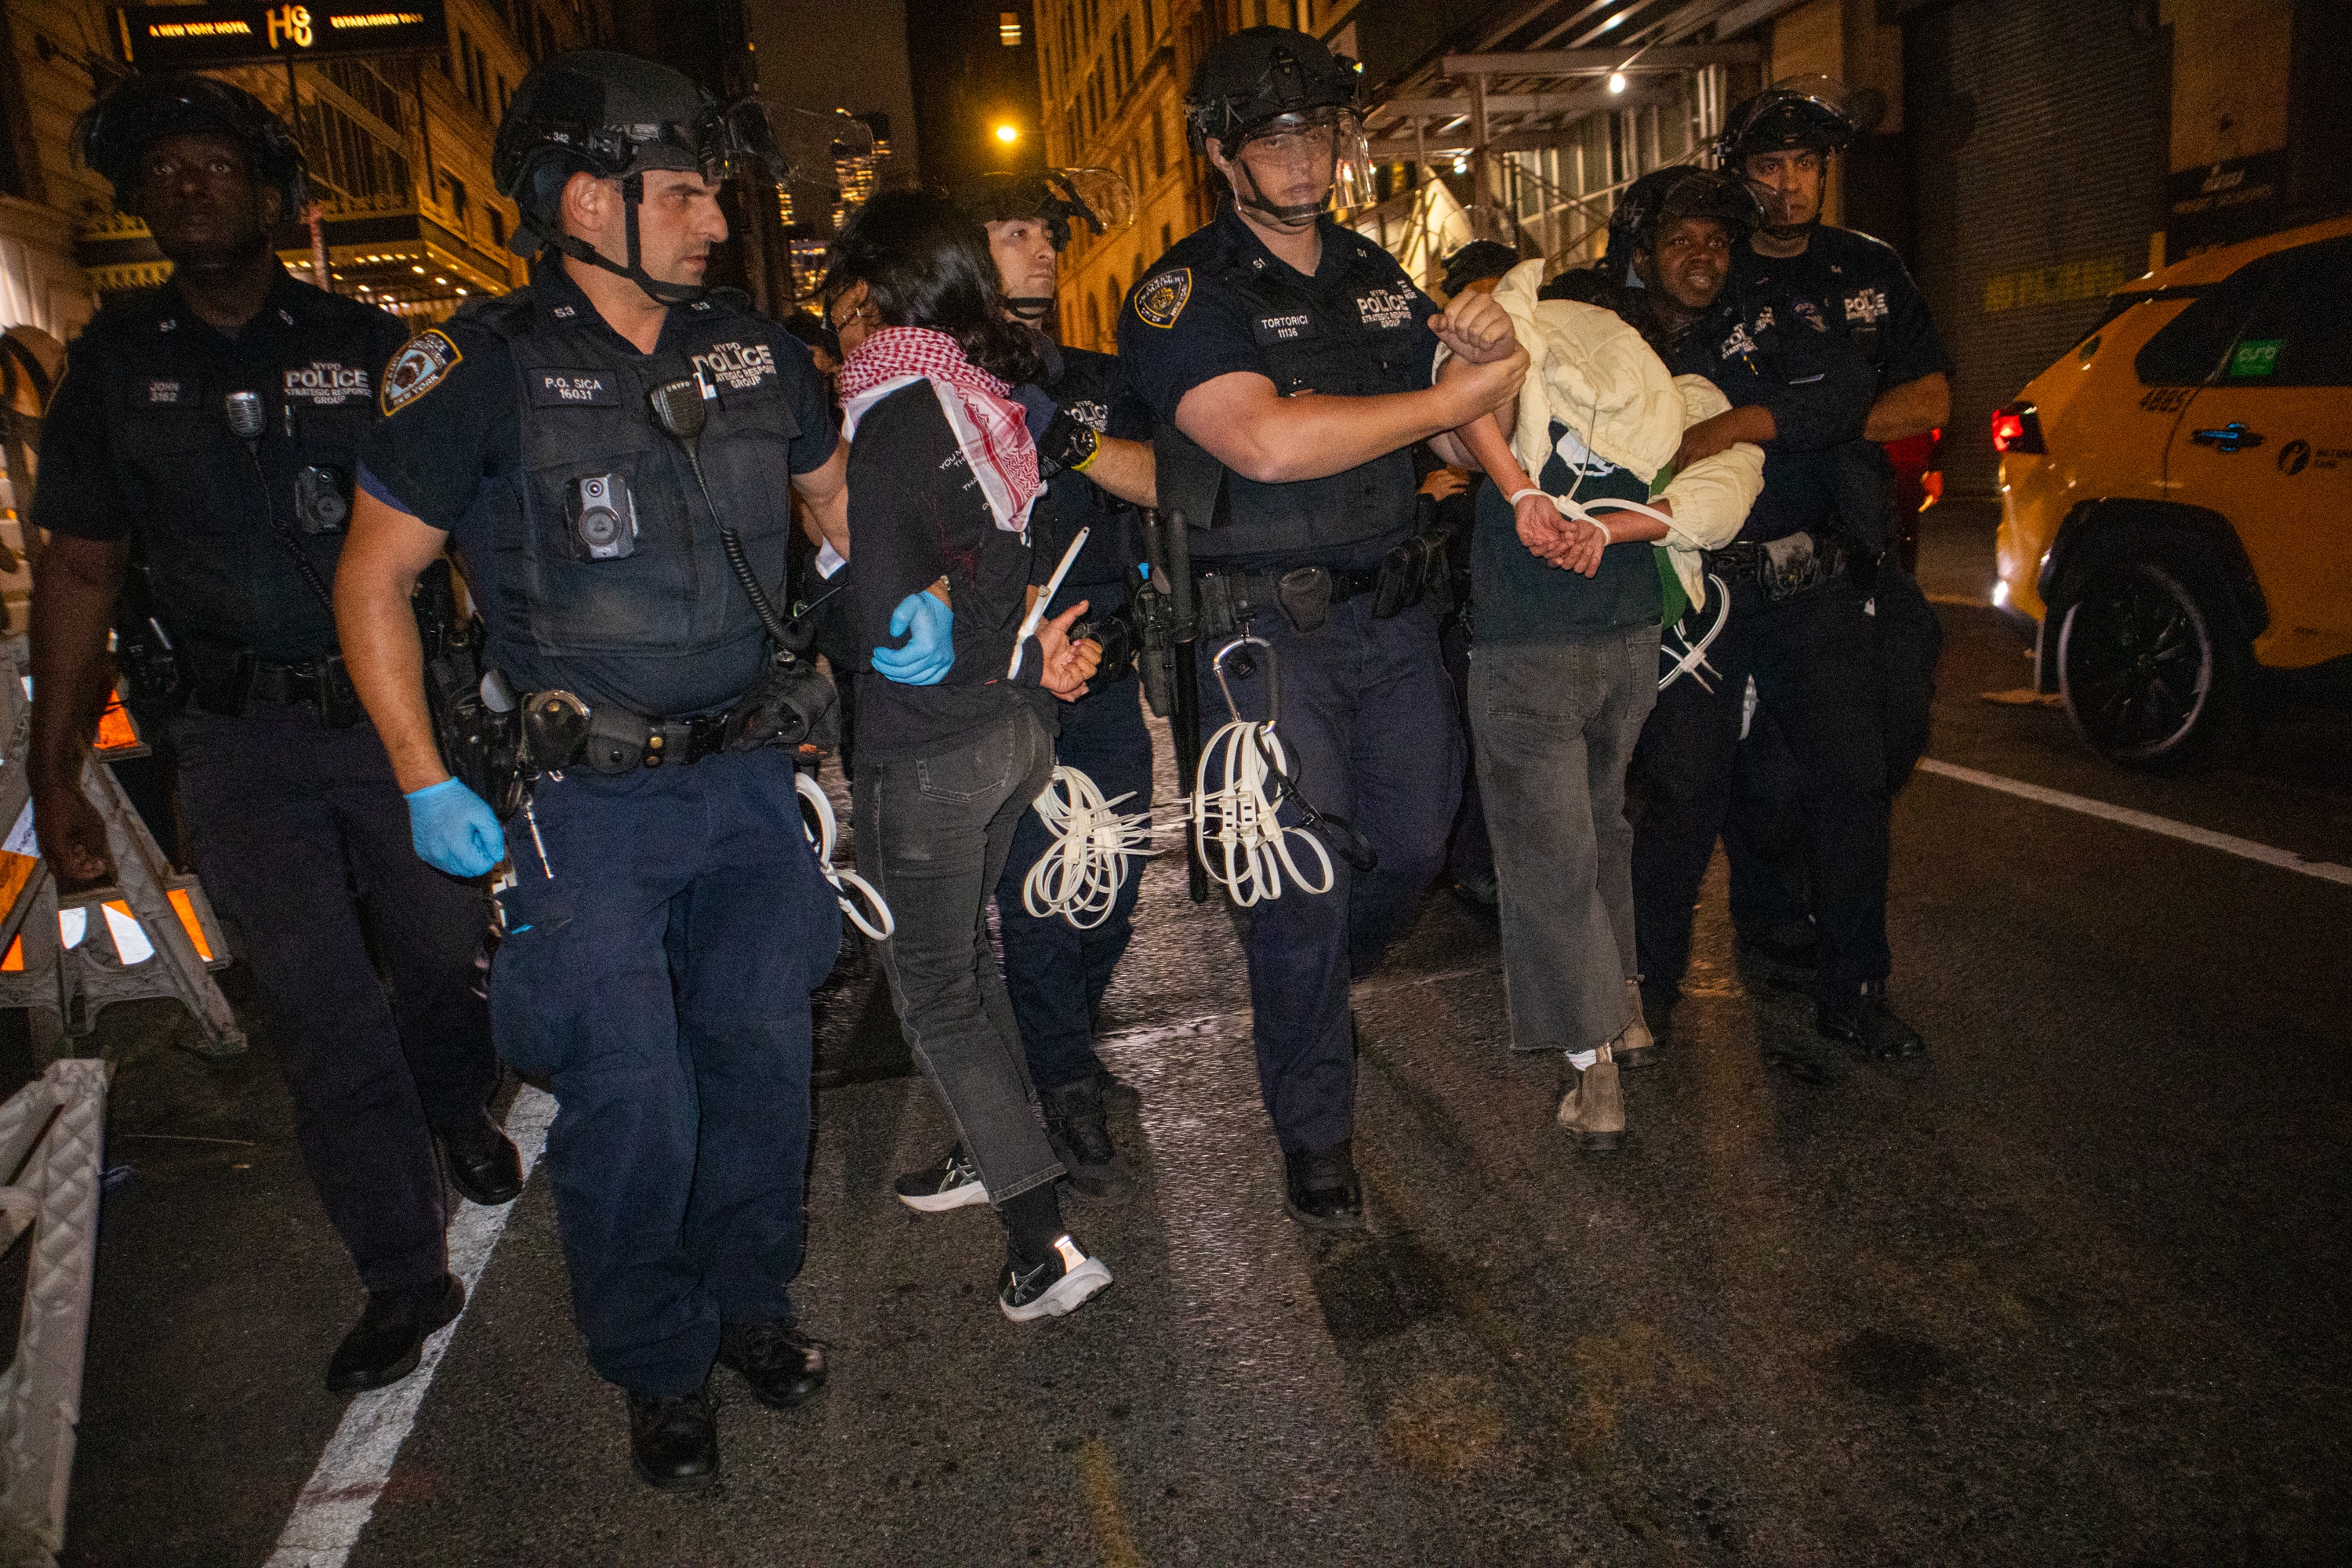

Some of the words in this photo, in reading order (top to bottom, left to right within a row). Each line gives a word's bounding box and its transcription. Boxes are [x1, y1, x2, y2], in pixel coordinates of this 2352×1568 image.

[330, 13, 399, 29] ESTABLISHED
[158, 24, 185, 37] NEW
[183, 21, 216, 36] YORK
[213, 20, 252, 34] HOTEL
[553, 132, 570, 144] 342
[1356, 294, 1410, 315] POLICE
[554, 305, 575, 318] S3
[1261, 315, 1309, 329] TORTORICI
[1362, 313, 1391, 324] STRATEGIC
[1381, 318, 1401, 328] GROUP
[1278, 328, 1299, 339] 11136
[712, 342, 741, 353] NYPD
[312, 361, 343, 371] NYPD
[285, 368, 368, 388] POLICE
[715, 369, 744, 383] ATEGIC
[730, 376, 761, 389] GROUP
[544, 377, 570, 389] P.O.
[573, 378, 603, 390] SICA
[671, 381, 691, 390] NYPD
[285, 387, 330, 396] STRATEGIC
[559, 388, 593, 401] 16031
[314, 395, 347, 405] GROUP
[1063, 404, 1109, 423] OLIC
[939, 453, 956, 471] YOU
